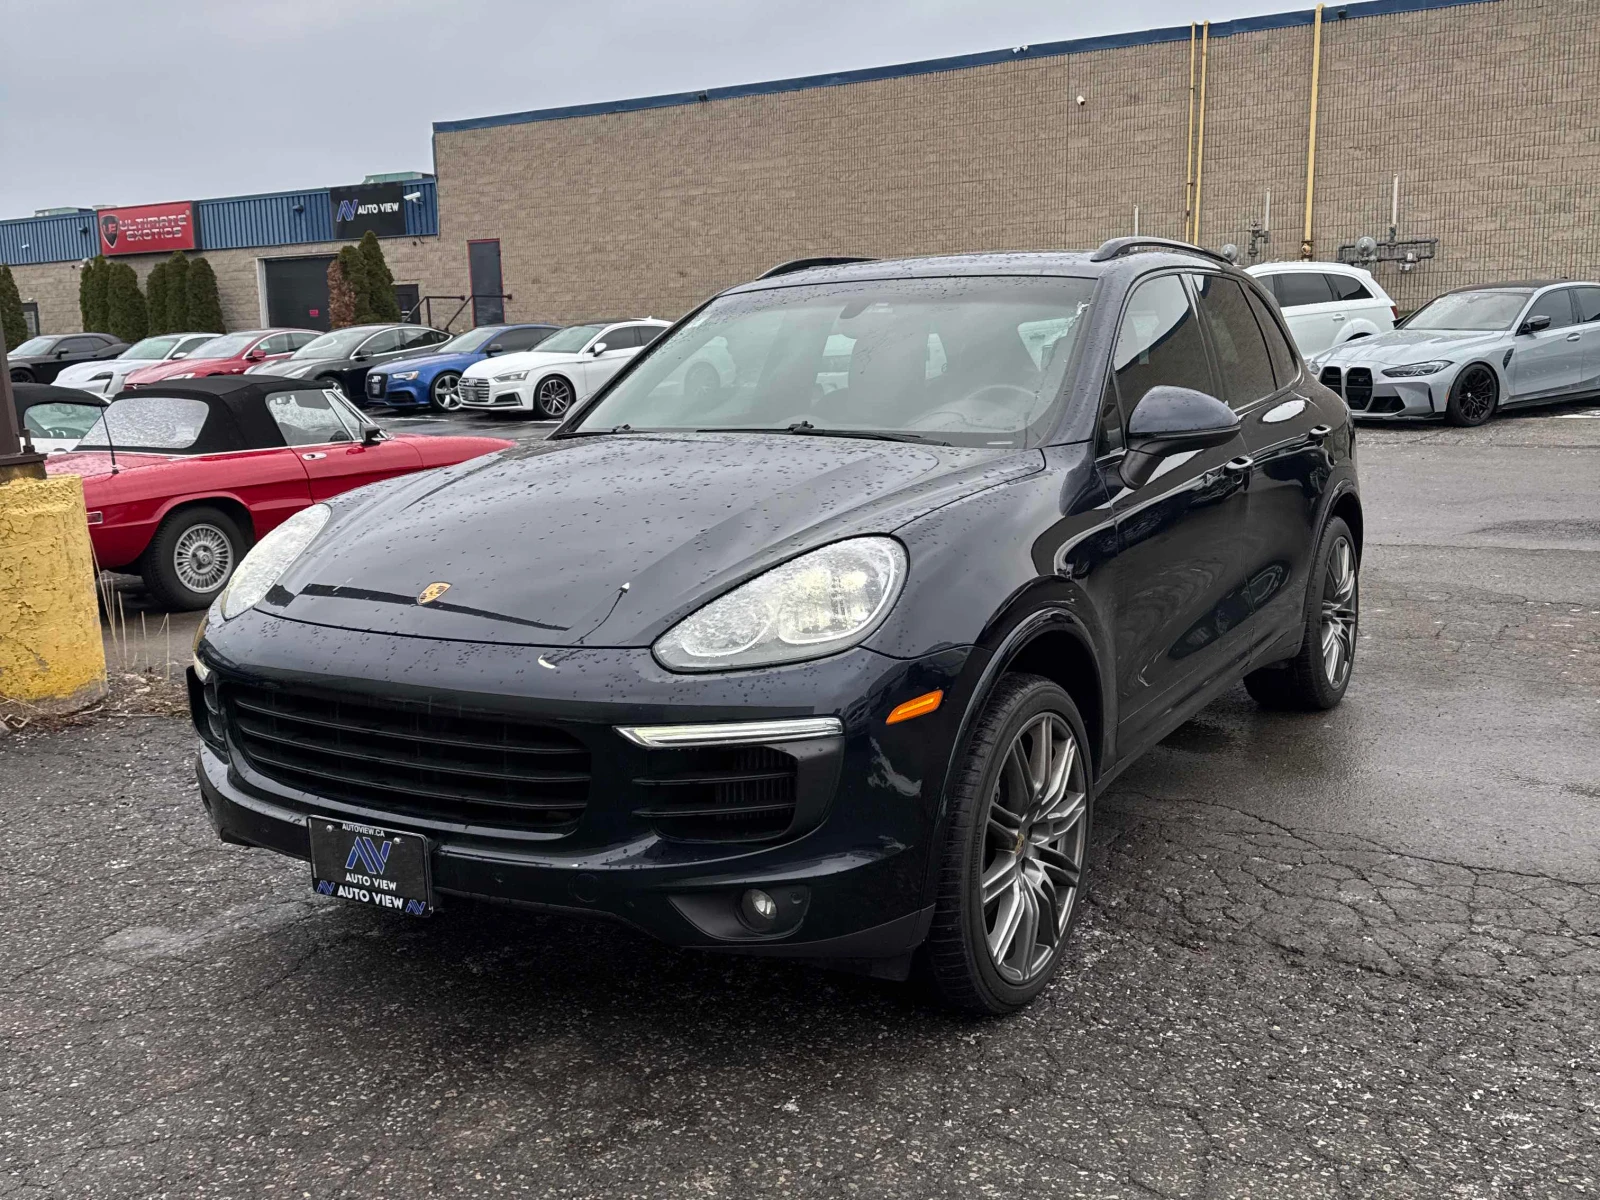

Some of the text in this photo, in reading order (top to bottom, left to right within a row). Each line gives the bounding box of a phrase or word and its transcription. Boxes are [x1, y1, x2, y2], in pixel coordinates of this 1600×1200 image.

[357, 202, 399, 215] AUTO VIEW
[119, 214, 187, 230] ULTIMATE
[126, 227, 182, 241] EXOTICS
[342, 823, 385, 837] AUTOVIEW.CA
[345, 872, 397, 891] AUTO VIEW
[337, 885, 404, 910] AUTO VIEW
